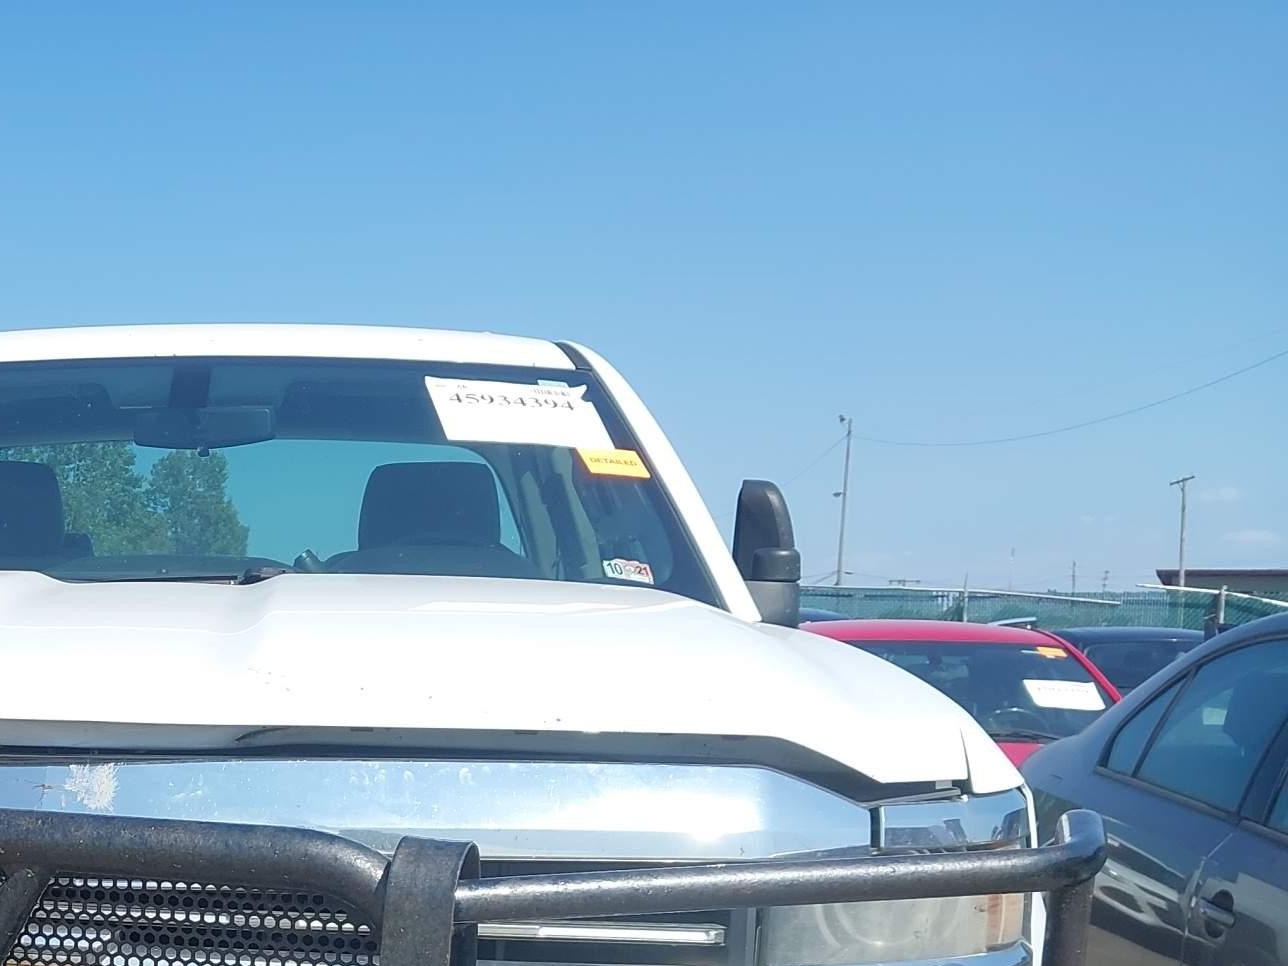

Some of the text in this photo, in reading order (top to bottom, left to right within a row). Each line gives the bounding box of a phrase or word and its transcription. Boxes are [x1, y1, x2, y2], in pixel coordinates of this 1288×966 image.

[449, 392, 575, 411] 45934394
[606, 561, 650, 577] 10 21
